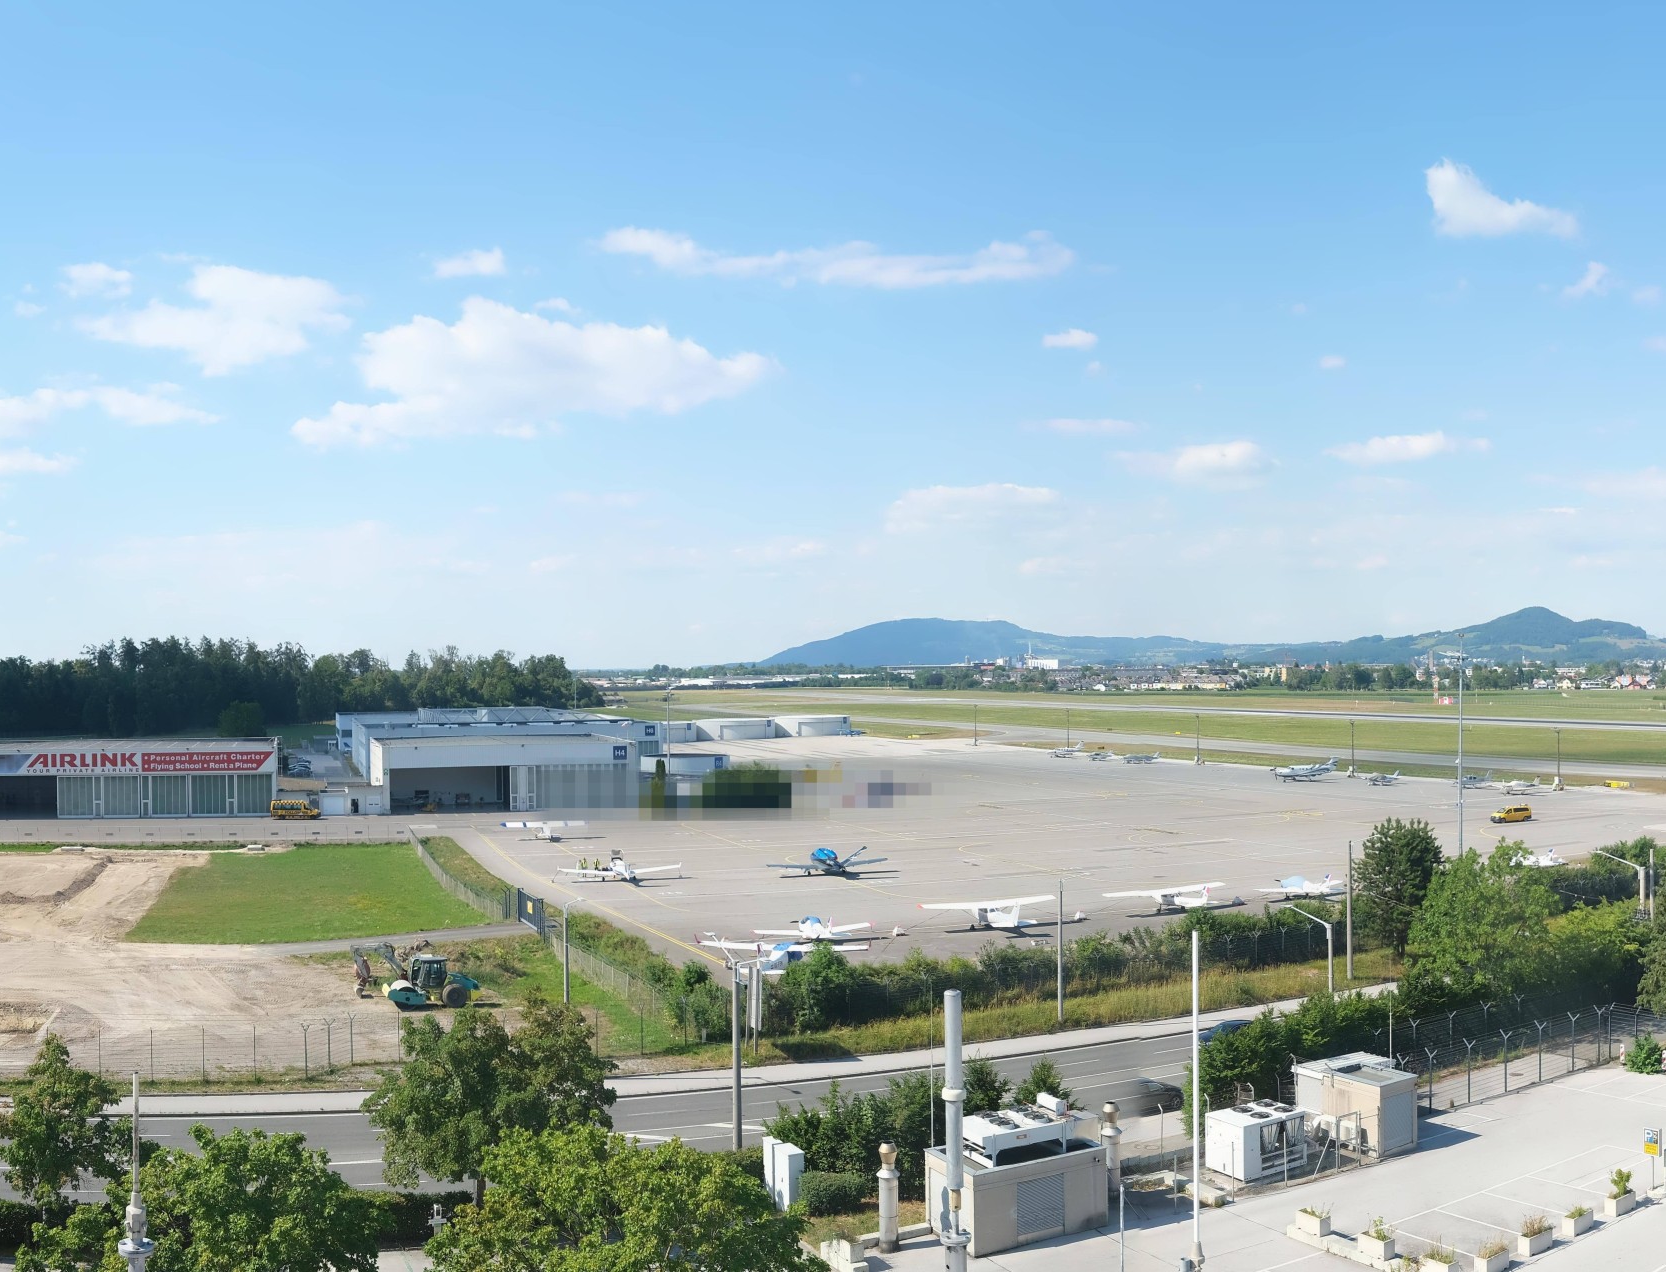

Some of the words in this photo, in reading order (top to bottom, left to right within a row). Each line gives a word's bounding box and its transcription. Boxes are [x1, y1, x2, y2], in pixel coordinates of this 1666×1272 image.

[614, 749, 626, 757] H4
[27, 753, 139, 768] AIRLINK
[150, 763, 174, 771] Flying
